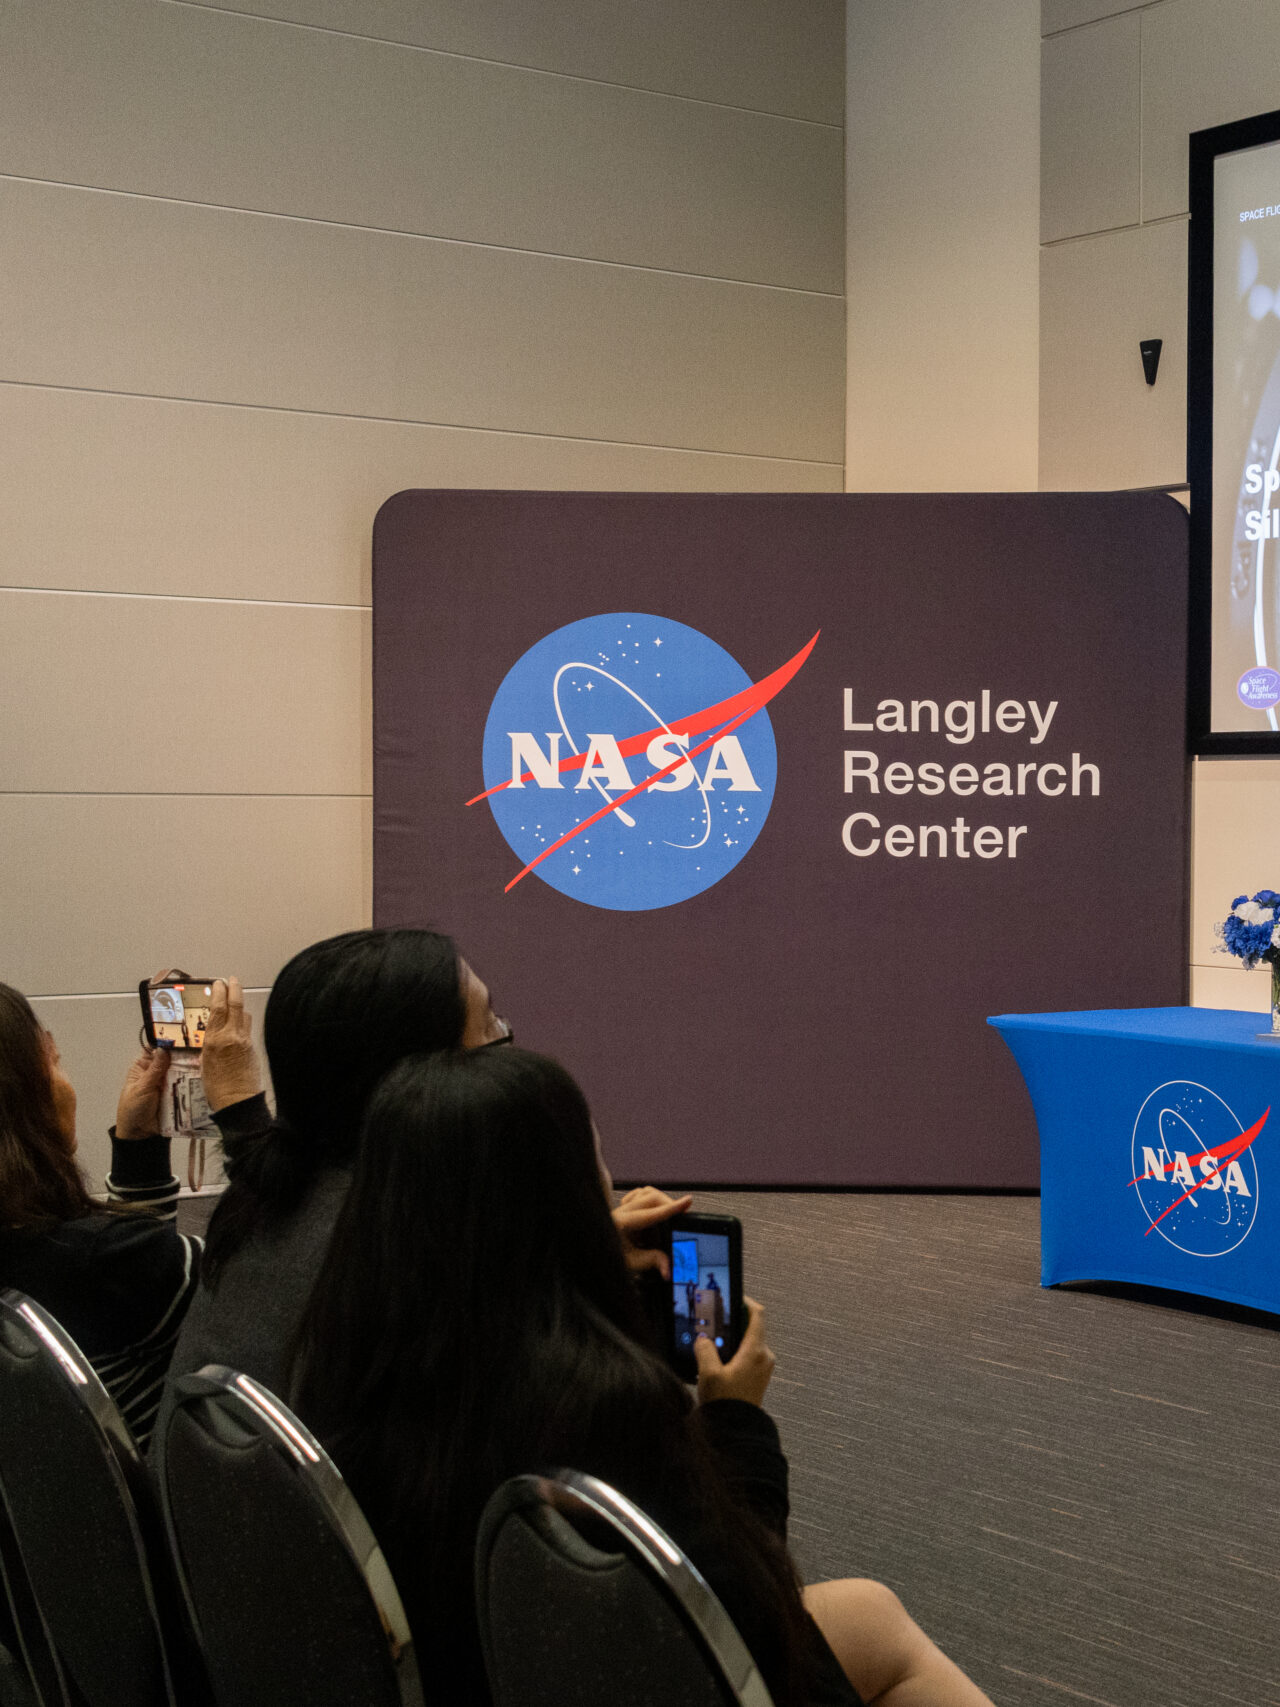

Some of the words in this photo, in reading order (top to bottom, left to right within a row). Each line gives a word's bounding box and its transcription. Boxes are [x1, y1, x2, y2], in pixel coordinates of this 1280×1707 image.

[1239, 207, 1265, 222] SPACE
[842, 688, 1059, 745] Langley
[506, 731, 762, 793] NASA
[842, 750, 1102, 797] Research
[840, 812, 1028, 859] Center
[1141, 1146, 1252, 1198] NASA
